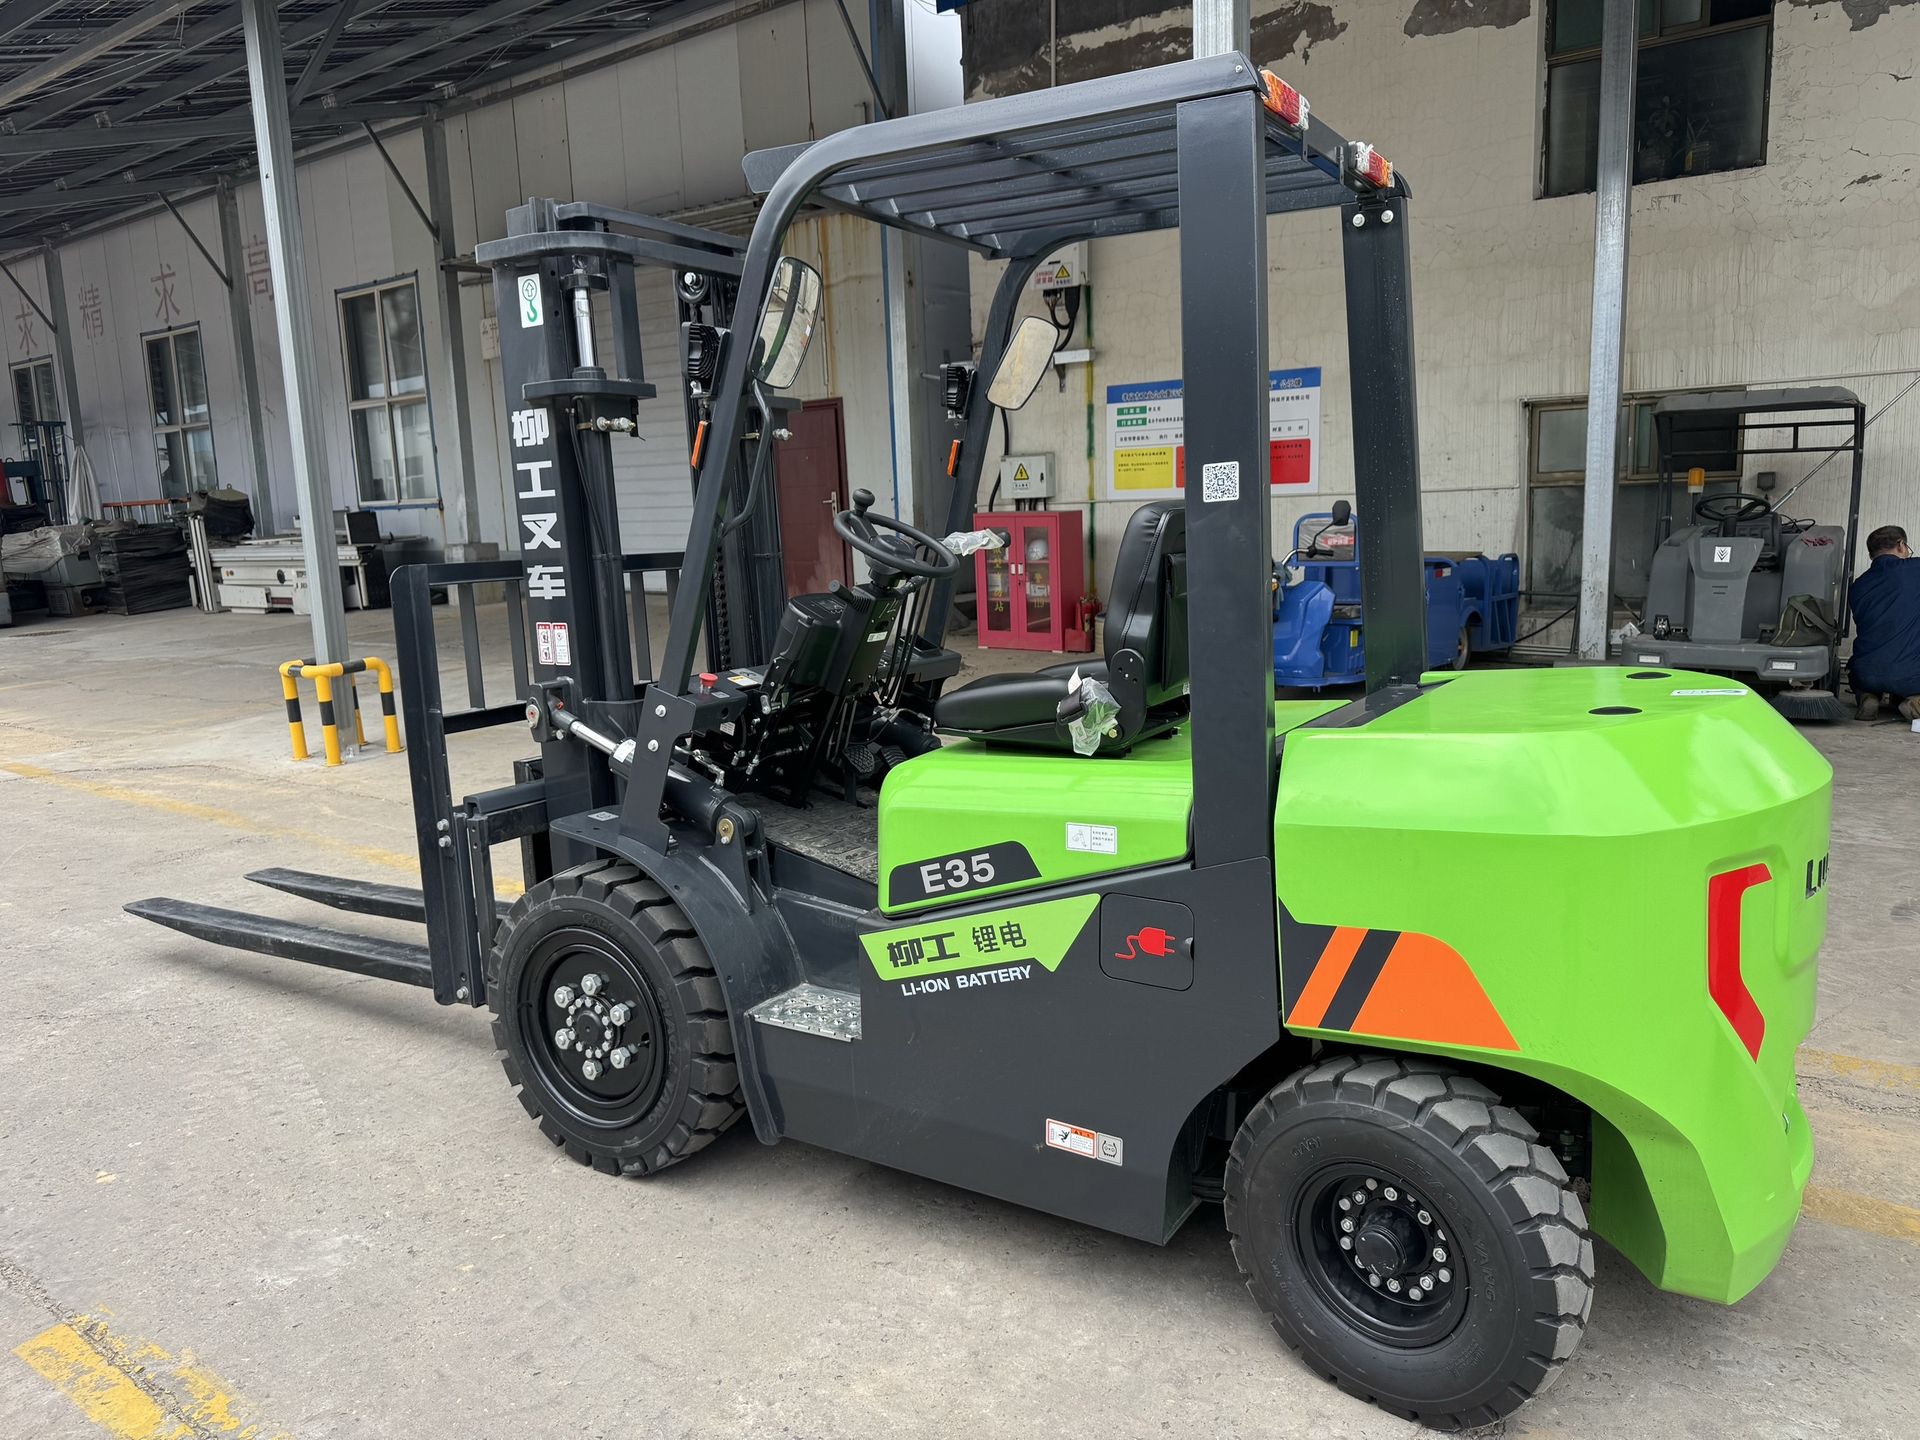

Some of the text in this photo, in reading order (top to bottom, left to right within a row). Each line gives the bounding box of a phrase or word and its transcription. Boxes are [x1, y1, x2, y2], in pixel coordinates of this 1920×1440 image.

[511, 407, 567, 601] 柳工叉车
[919, 853, 996, 894] E35
[887, 921, 1027, 968] 柳工 锂电
[901, 965, 1031, 996] LI-ION BATTERY
